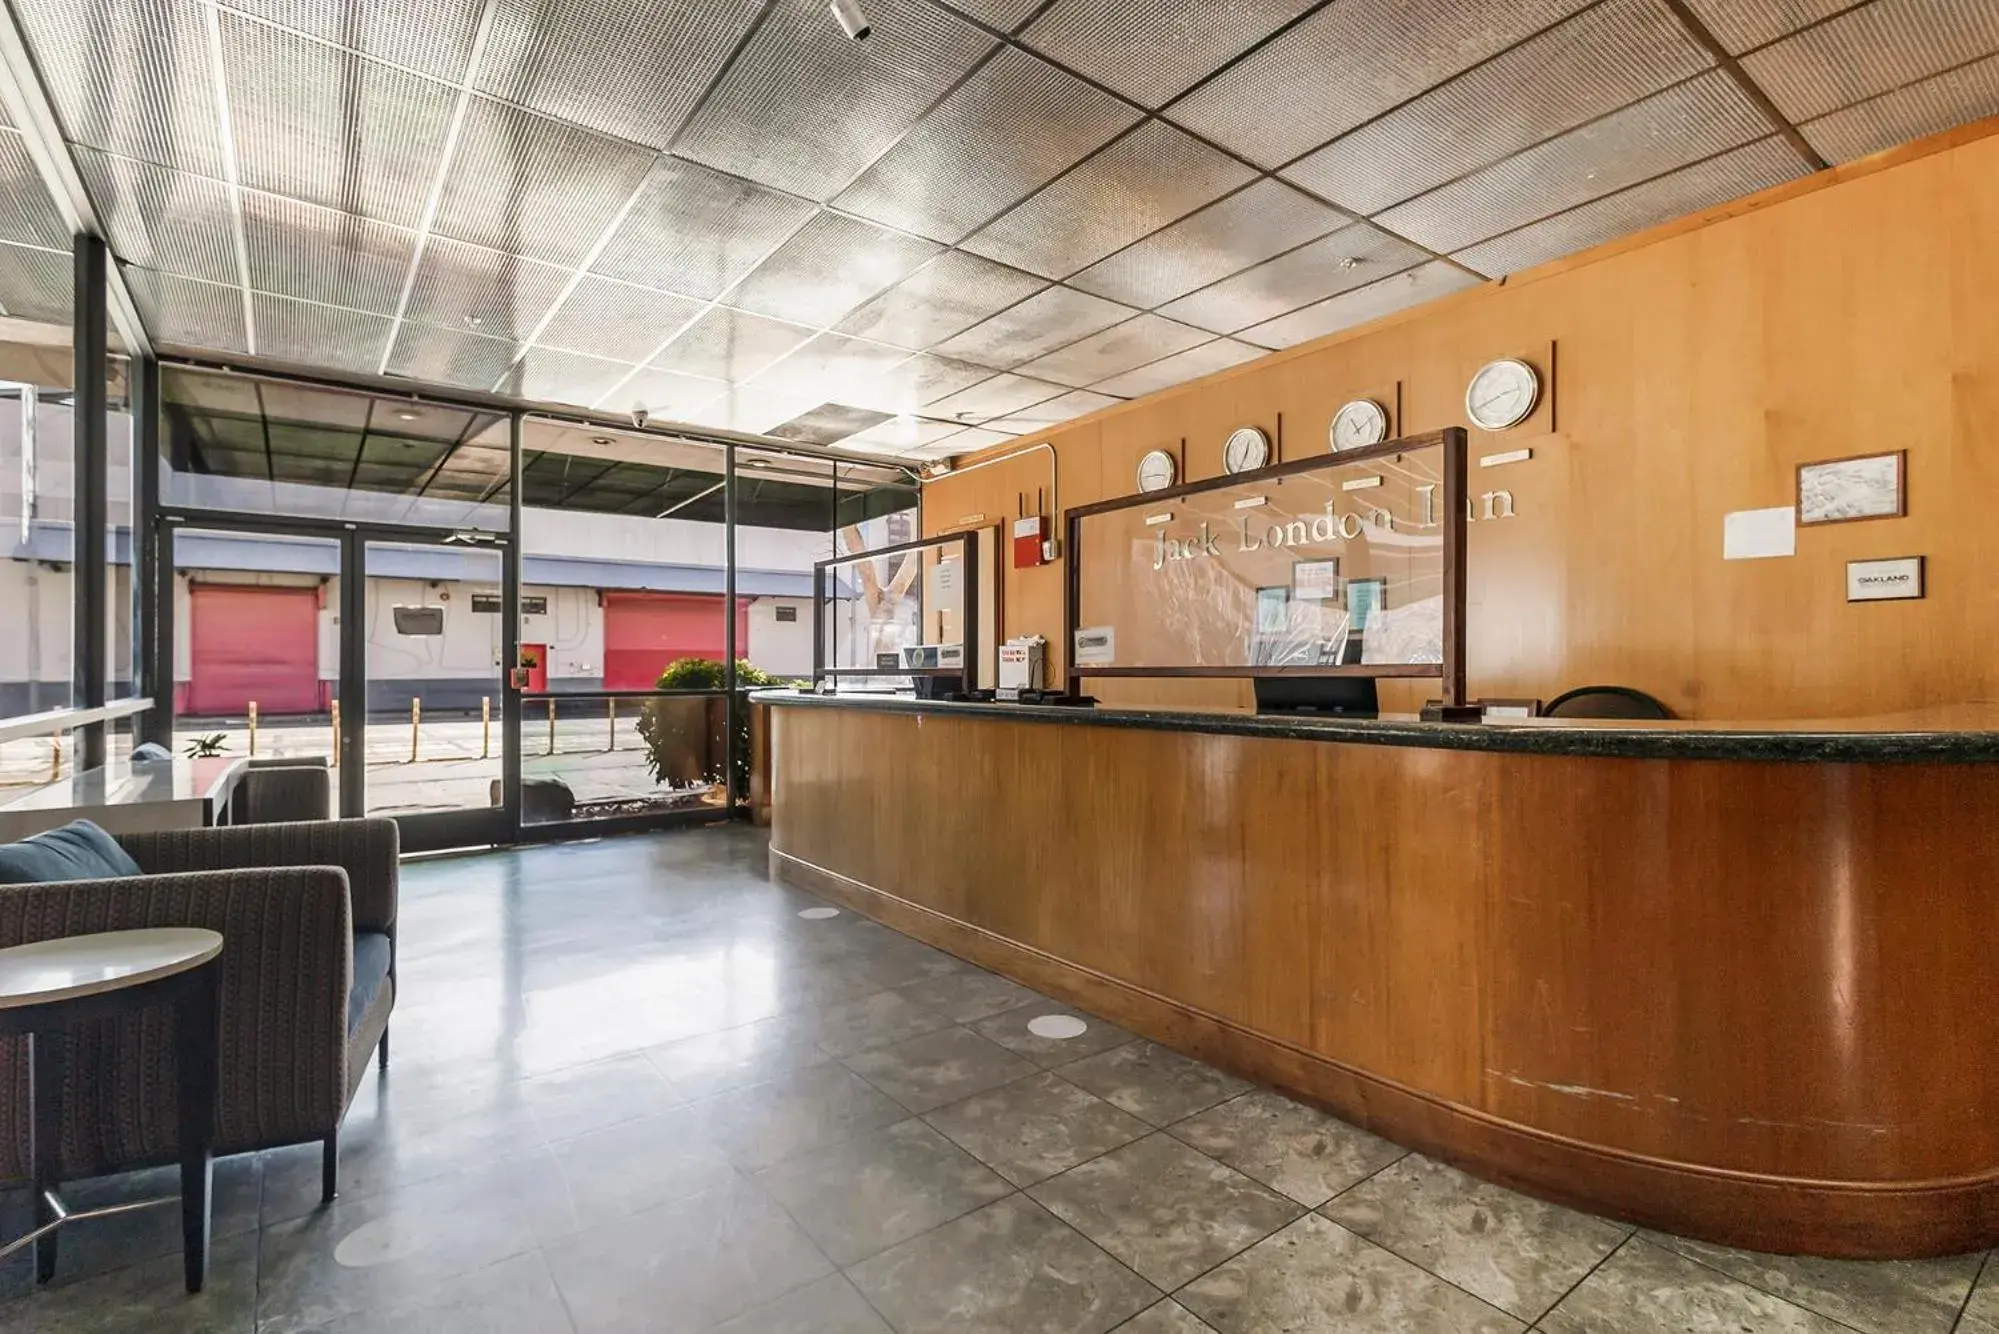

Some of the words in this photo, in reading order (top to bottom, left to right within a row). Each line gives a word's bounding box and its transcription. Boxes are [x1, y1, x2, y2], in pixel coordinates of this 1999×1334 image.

[1153, 520, 1221, 570] Jack
[1239, 499, 1395, 553] London
[1415, 484, 1516, 528] In
[1858, 574, 1909, 583] OAKLAND
